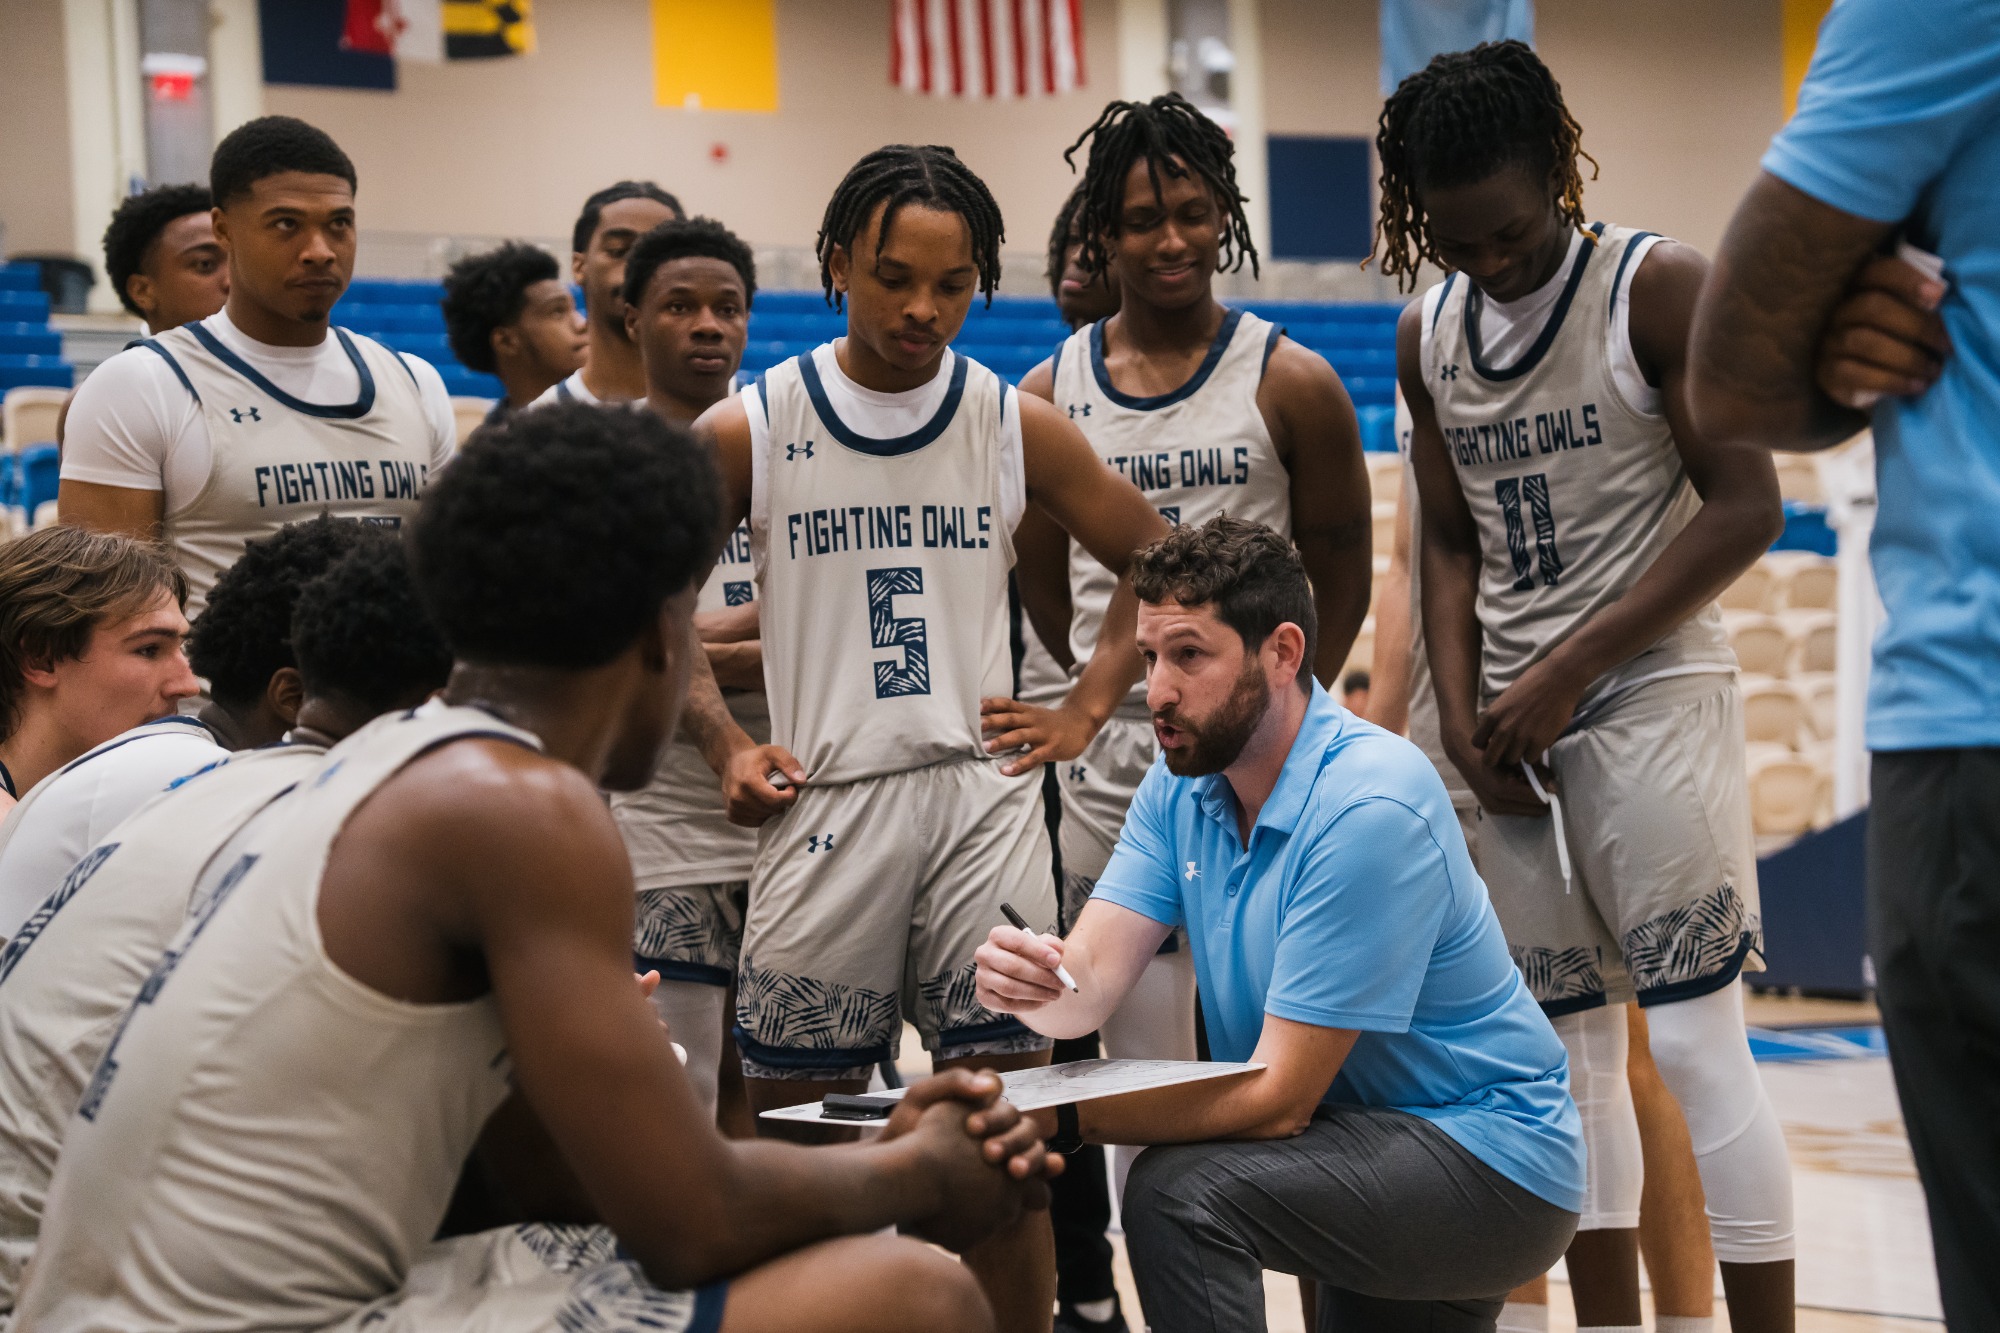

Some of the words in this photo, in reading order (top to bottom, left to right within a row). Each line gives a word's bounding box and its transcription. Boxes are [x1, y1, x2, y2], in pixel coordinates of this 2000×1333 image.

[1444, 417, 1532, 466] FIGHTING
[1535, 403, 1603, 454] OWLS
[255, 460, 374, 507] FIGHTING
[1107, 452, 1171, 491] TING
[1180, 447, 1249, 488] OWLS
[788, 505, 913, 560] FIGHTING
[922, 505, 991, 549] OWLS
[1495, 473, 1563, 590] 11
[866, 566, 931, 699] 5
